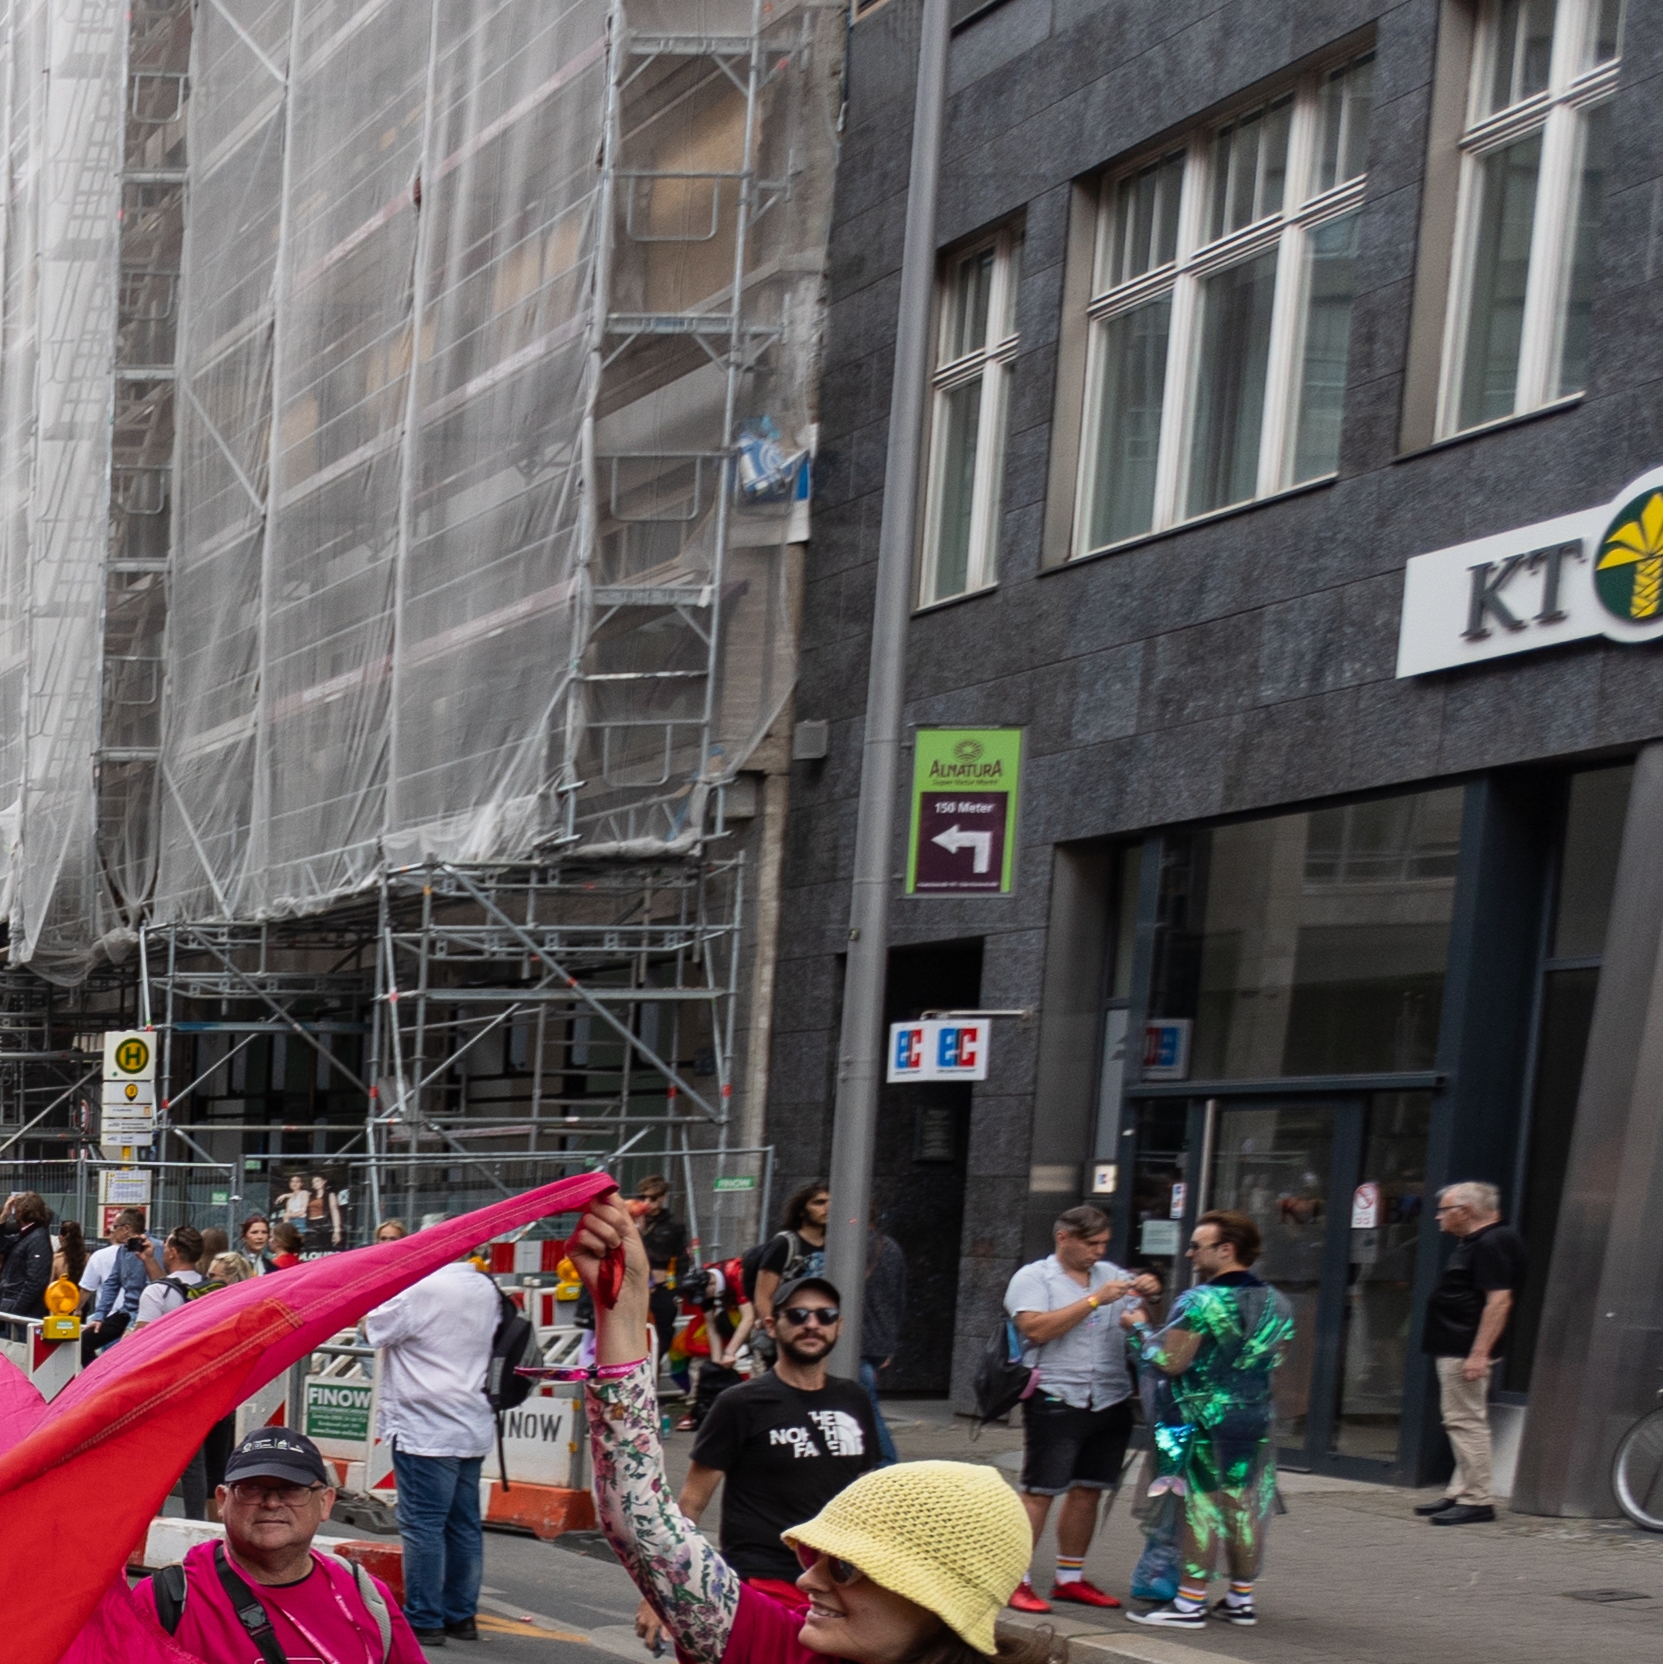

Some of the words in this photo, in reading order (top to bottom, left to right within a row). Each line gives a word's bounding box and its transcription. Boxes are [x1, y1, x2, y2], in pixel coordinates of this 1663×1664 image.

[1459, 538, 1587, 641] KT
[929, 759, 1003, 779] ALNATURA
[934, 801, 956, 814] 150
[958, 801, 994, 814] Meter
[125, 1046, 141, 1066] H
[308, 1387, 371, 1408] FINOW
